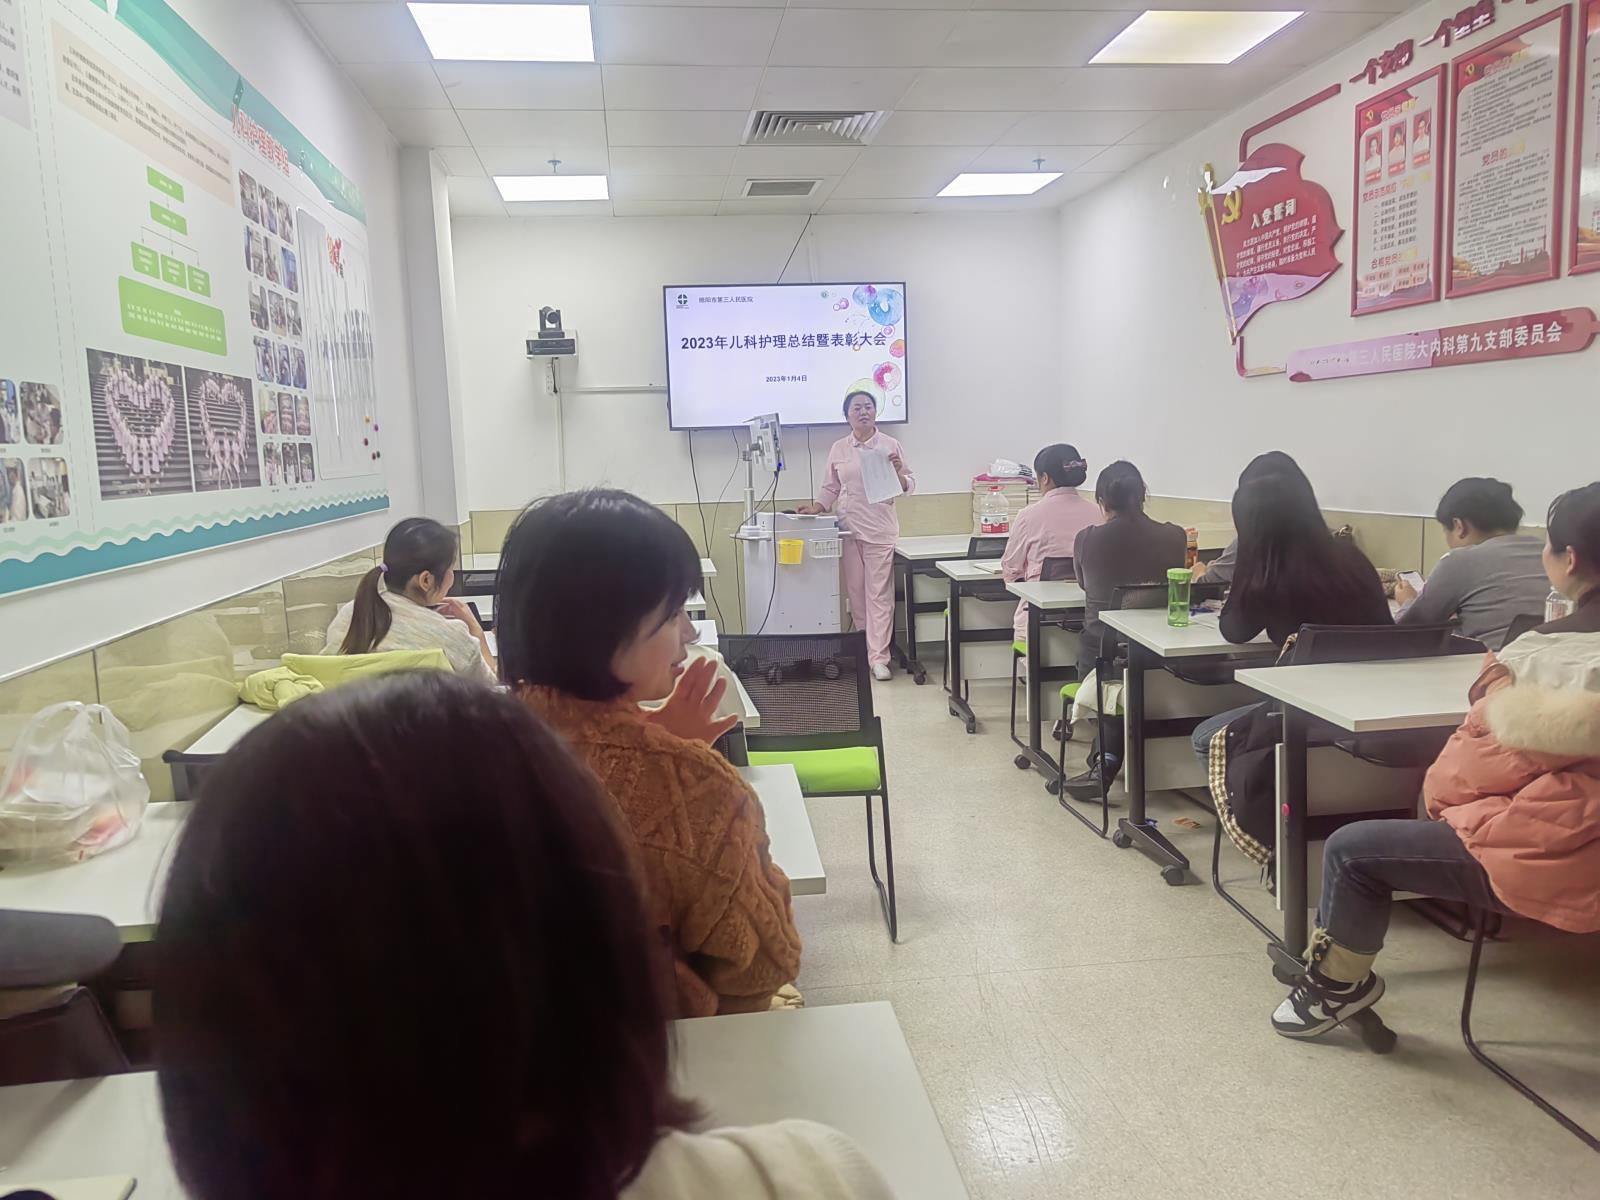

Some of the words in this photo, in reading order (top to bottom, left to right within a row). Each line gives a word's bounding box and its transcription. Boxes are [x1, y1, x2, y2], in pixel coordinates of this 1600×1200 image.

[681, 332, 886, 350] 2023年儿科护理总结暨表彰大会
[766, 374, 807, 383] 2023年1月4日
